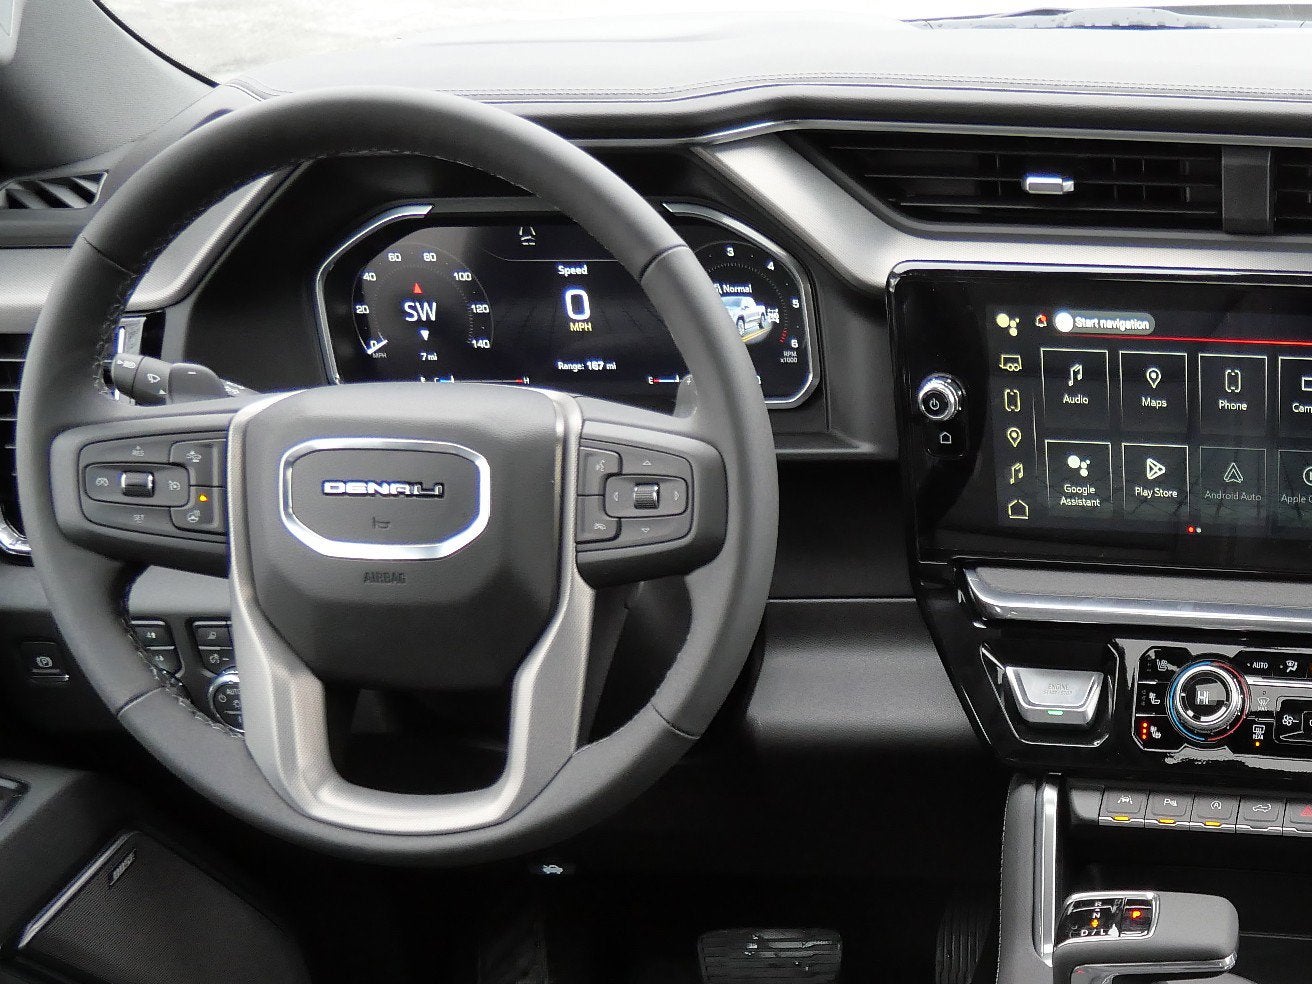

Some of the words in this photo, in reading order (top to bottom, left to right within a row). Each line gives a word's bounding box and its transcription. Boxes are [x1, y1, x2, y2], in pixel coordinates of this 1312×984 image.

[388, 252, 402, 262] 60
[423, 252, 437, 262] 80
[726, 247, 735, 257] 3
[558, 264, 588, 277] Speed
[767, 261, 775, 271] 4
[362, 272, 377, 281] 40
[453, 272, 472, 281] 100
[723, 284, 752, 294] Normal
[470, 304, 490, 314] 120
[564, 288, 591, 320] 0
[792, 299, 800, 309] 5
[356, 306, 370, 314] 20
[404, 302, 437, 322] SW
[570, 322, 592, 332] MPH
[1074, 316, 1099, 329] Start
[1100, 318, 1150, 332] navigation
[472, 340, 490, 349] 140
[420, 352, 426, 360] 7
[428, 352, 438, 360] mi
[557, 361, 585, 372] Range:
[606, 362, 616, 370] mi
[1063, 394, 1088, 405] Audio
[1142, 397, 1168, 410] Maps
[1218, 400, 1247, 412] Phone
[322, 480, 444, 497] DENALI
[1064, 484, 1096, 496] Google
[1134, 486, 1152, 498] Play
[1154, 488, 1178, 498] Store
[1060, 496, 1100, 507] Assistant
[1204, 490, 1239, 500] Android
[1240, 492, 1262, 502] Auto
[1280, 494, 1307, 505] Apple
[1252, 662, 1268, 670] AUTO
[1197, 690, 1210, 704] HI
